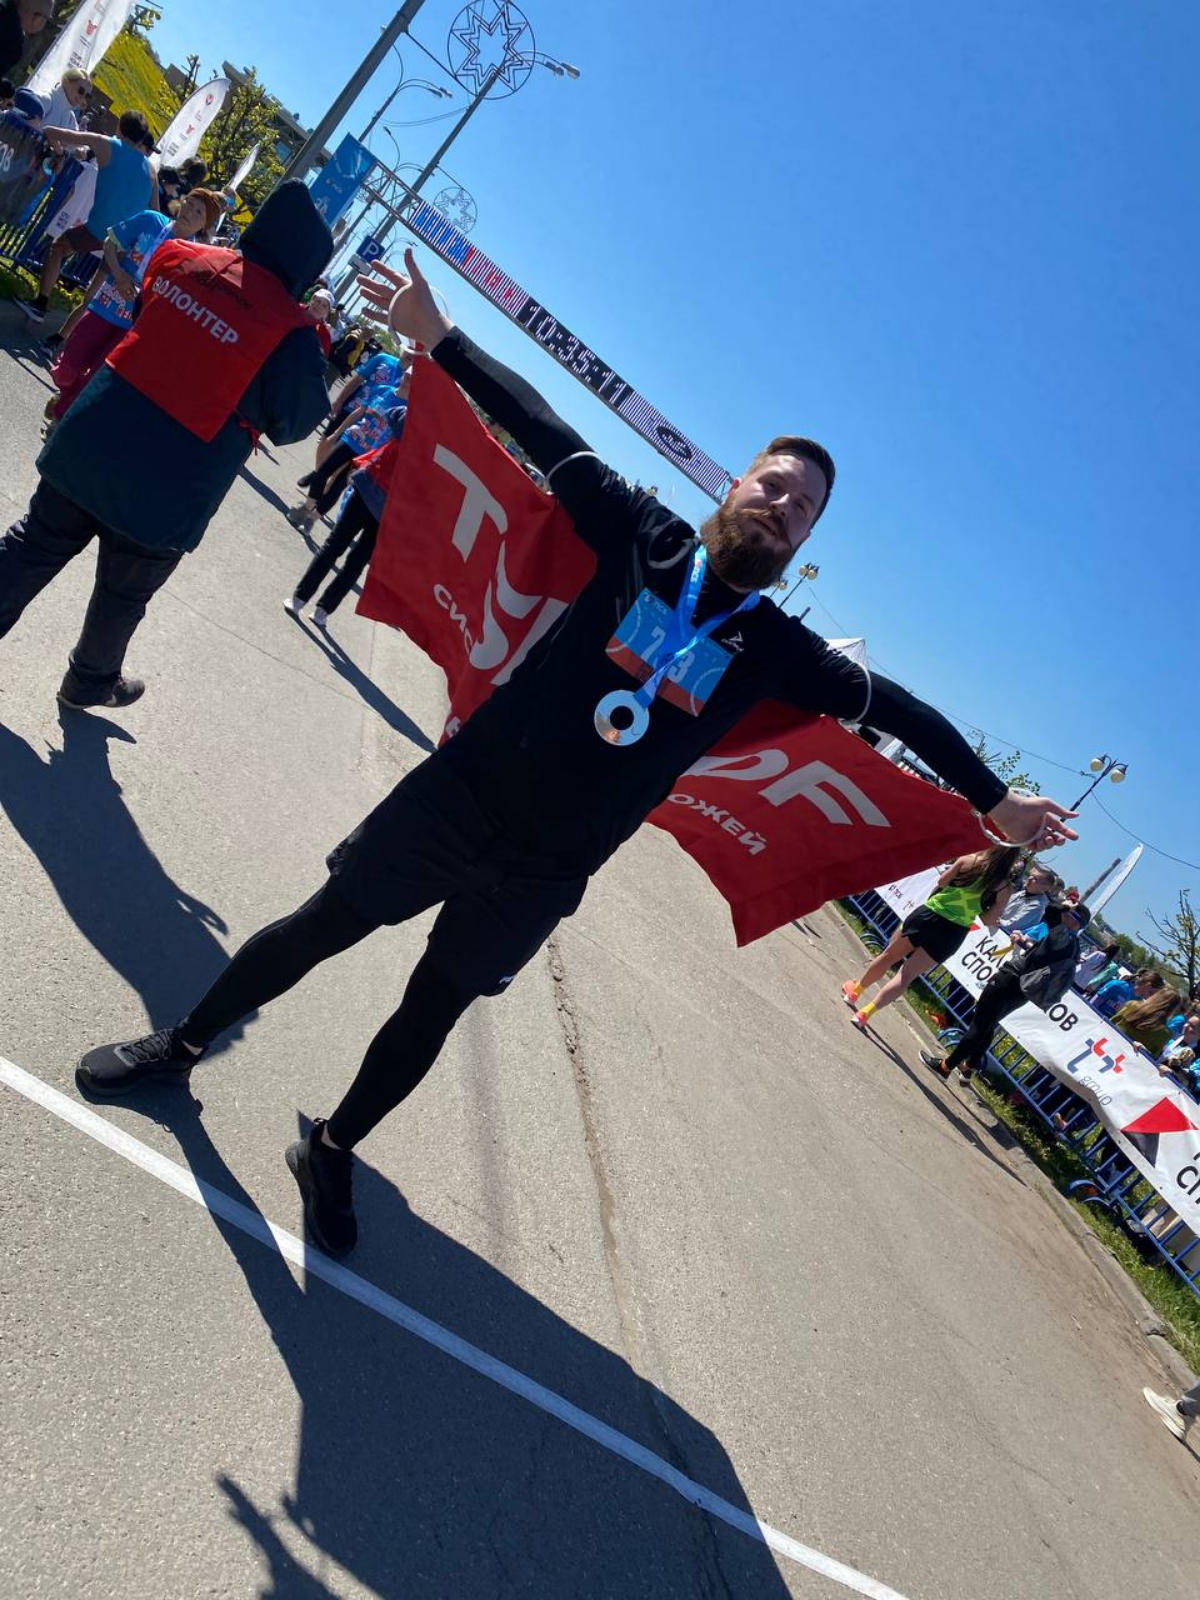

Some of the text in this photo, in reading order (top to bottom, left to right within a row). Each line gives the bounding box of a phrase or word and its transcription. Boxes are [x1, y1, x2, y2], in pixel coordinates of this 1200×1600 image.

[362, 240, 380, 256] P
[152, 275, 240, 344] ВОЛОНТЕР
[523, 304, 627, 404] 10:35:11
